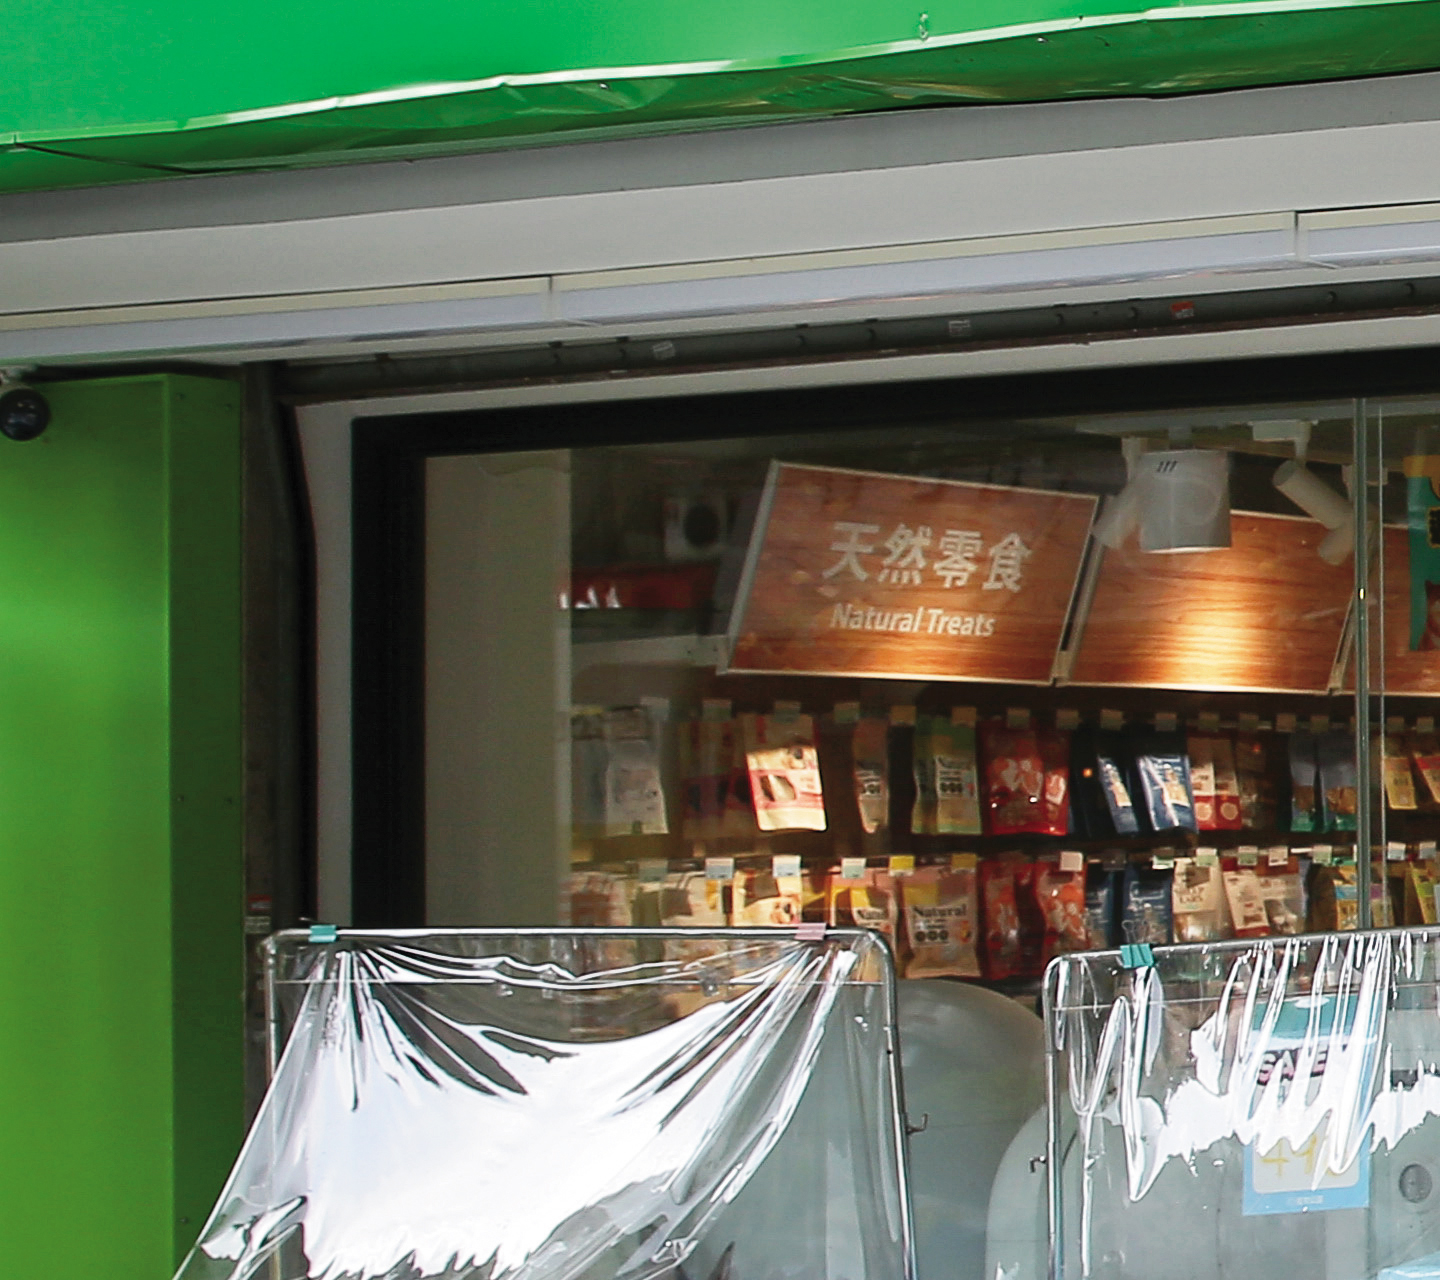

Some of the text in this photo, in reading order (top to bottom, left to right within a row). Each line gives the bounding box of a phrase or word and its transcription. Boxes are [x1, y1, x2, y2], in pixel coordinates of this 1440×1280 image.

[822, 521, 1032, 594] 天然零食
[831, 602, 996, 638] Natural Treats
